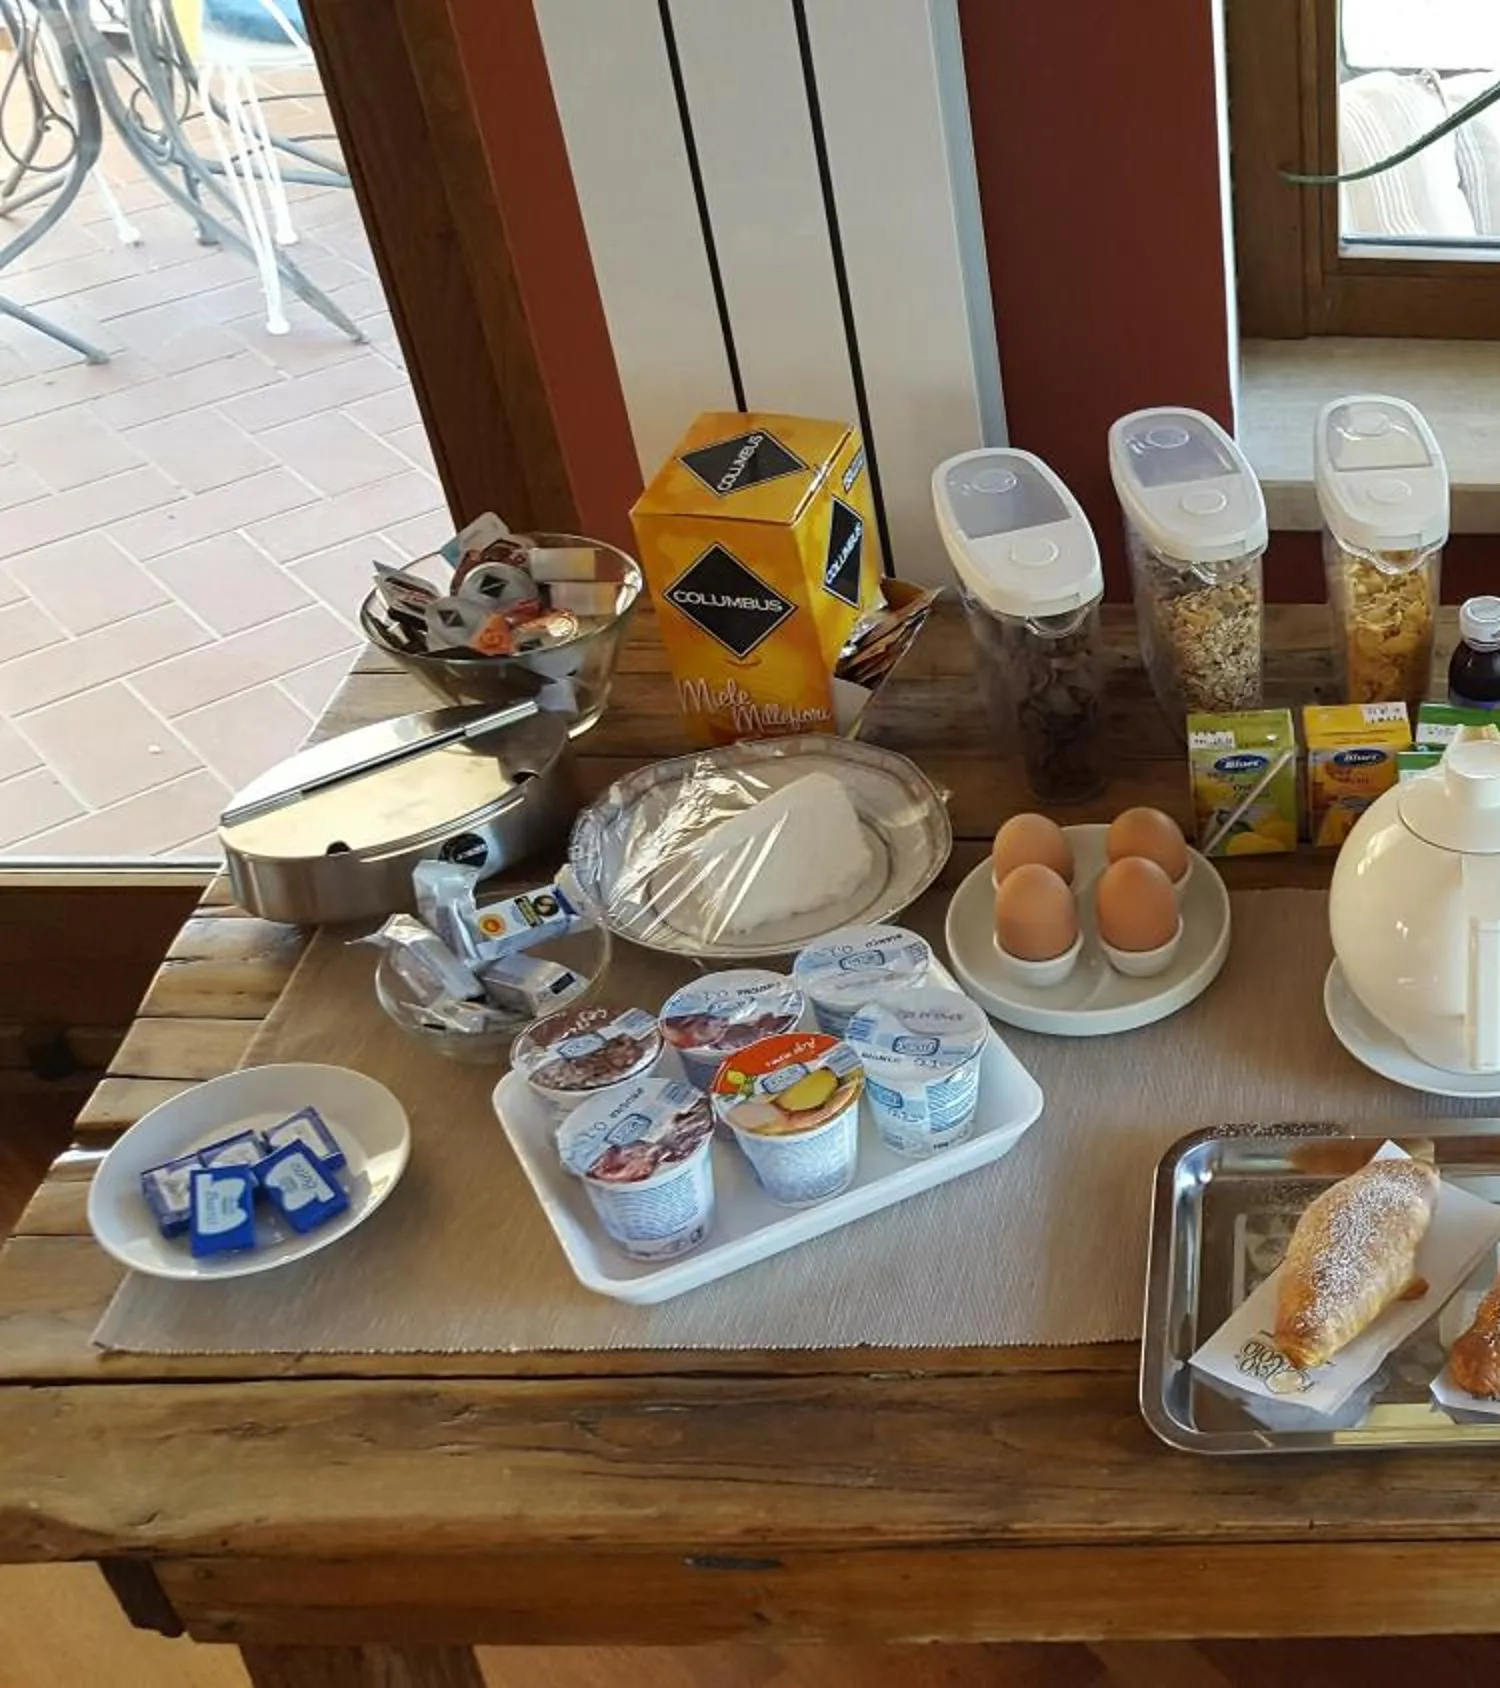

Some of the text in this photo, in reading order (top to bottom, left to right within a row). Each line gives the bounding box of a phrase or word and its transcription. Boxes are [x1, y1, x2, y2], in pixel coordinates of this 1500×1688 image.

[716, 433, 765, 492] COLUMBUS
[672, 591, 783, 612] COLUMBUS
[678, 678, 751, 713] Miele
